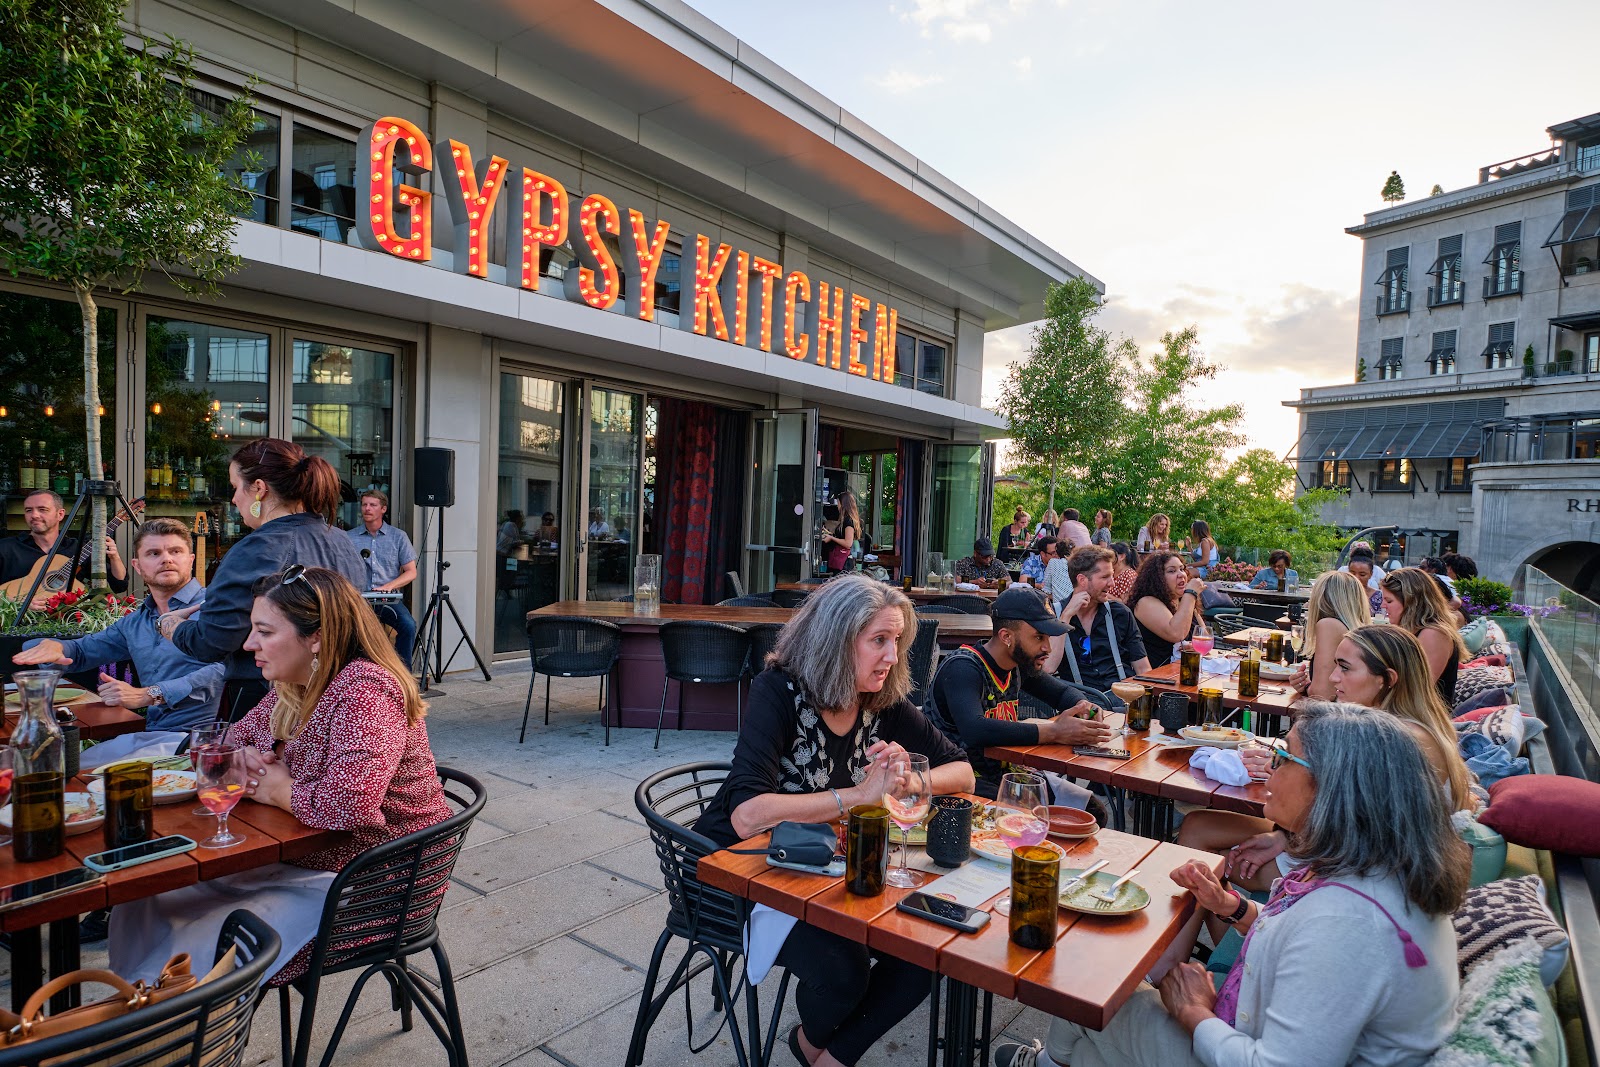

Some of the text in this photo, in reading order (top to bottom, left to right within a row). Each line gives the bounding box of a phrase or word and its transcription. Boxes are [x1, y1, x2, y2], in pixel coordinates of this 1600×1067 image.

[368, 115, 899, 385] GYPSY KITCHEN
[1566, 498, 1600, 513] RH
